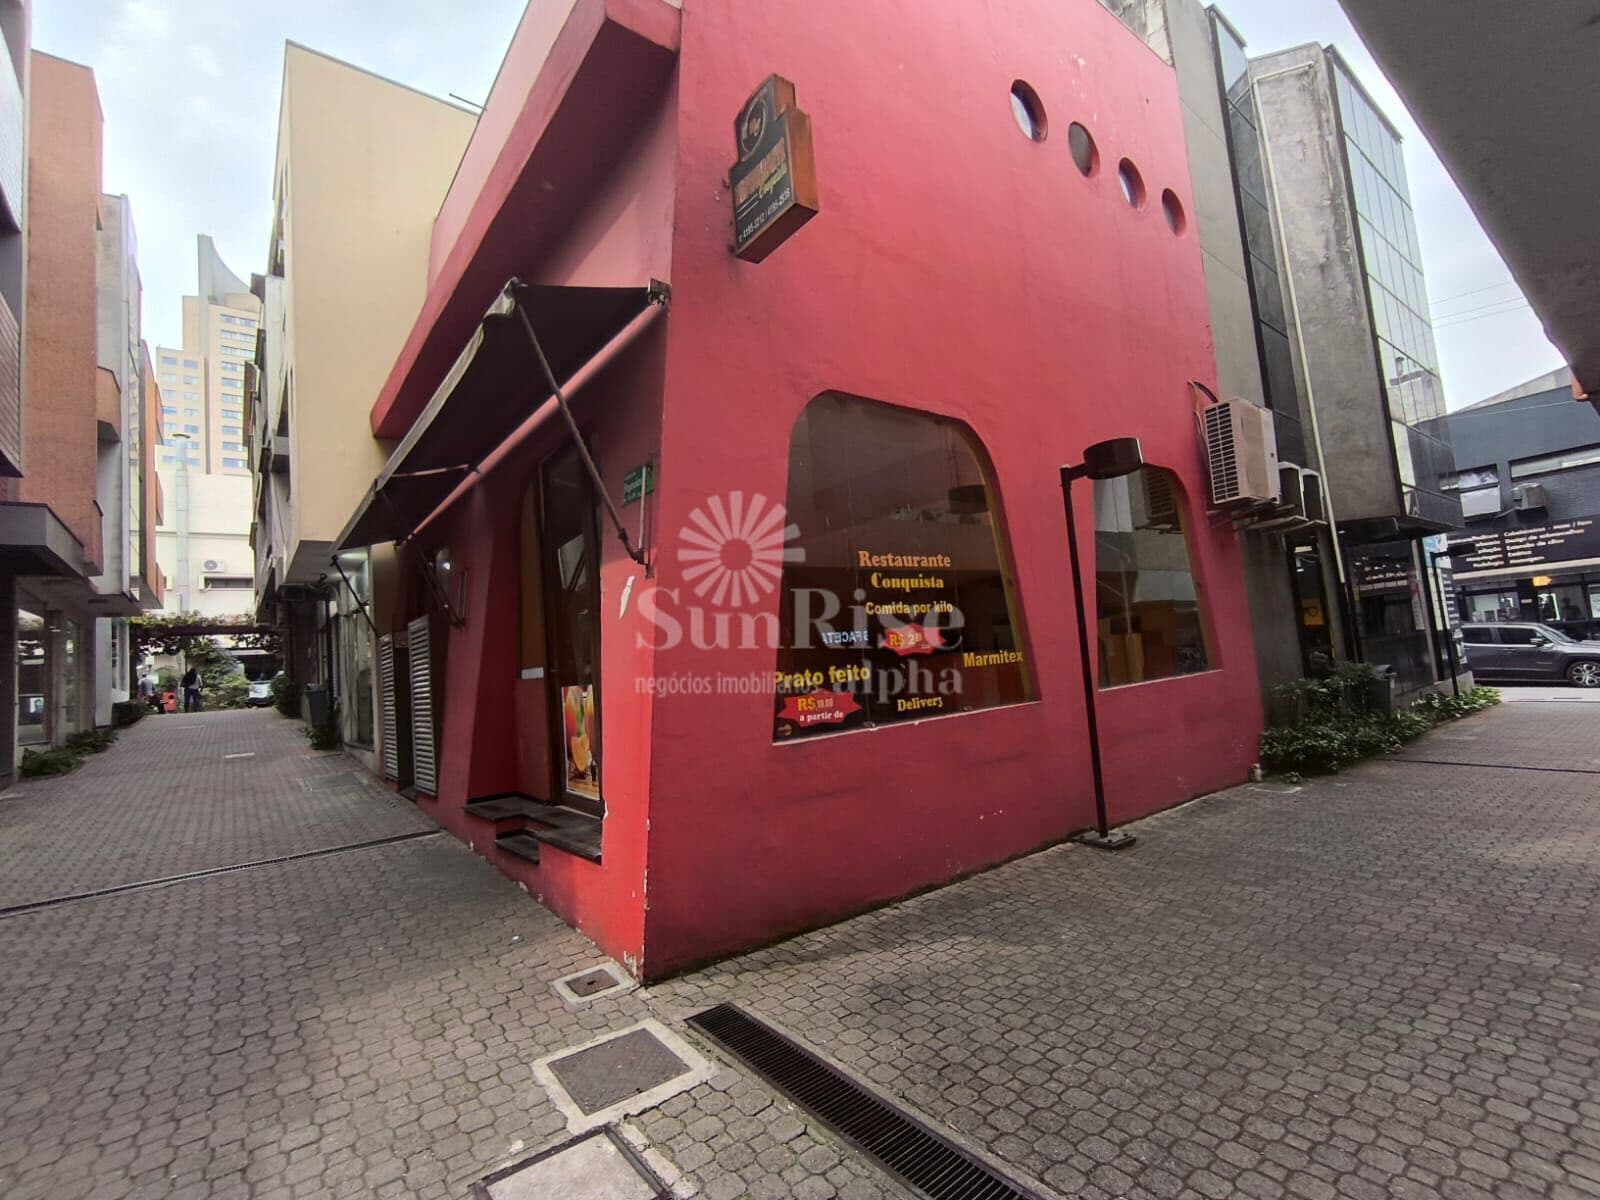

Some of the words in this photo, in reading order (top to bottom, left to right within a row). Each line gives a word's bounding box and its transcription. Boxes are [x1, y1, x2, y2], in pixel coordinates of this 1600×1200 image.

[858, 550, 951, 567] Restaurante
[870, 572, 944, 592] Conquista
[865, 601, 910, 616] Comida
[913, 602, 932, 616] por
[933, 600, 953, 614] kilo
[963, 650, 1024, 668] Marmitex
[774, 667, 824, 689] Prato
[829, 664, 871, 684] feito
[799, 714, 805, 722] a
[807, 711, 833, 723] partir
[834, 710, 844, 720] de
